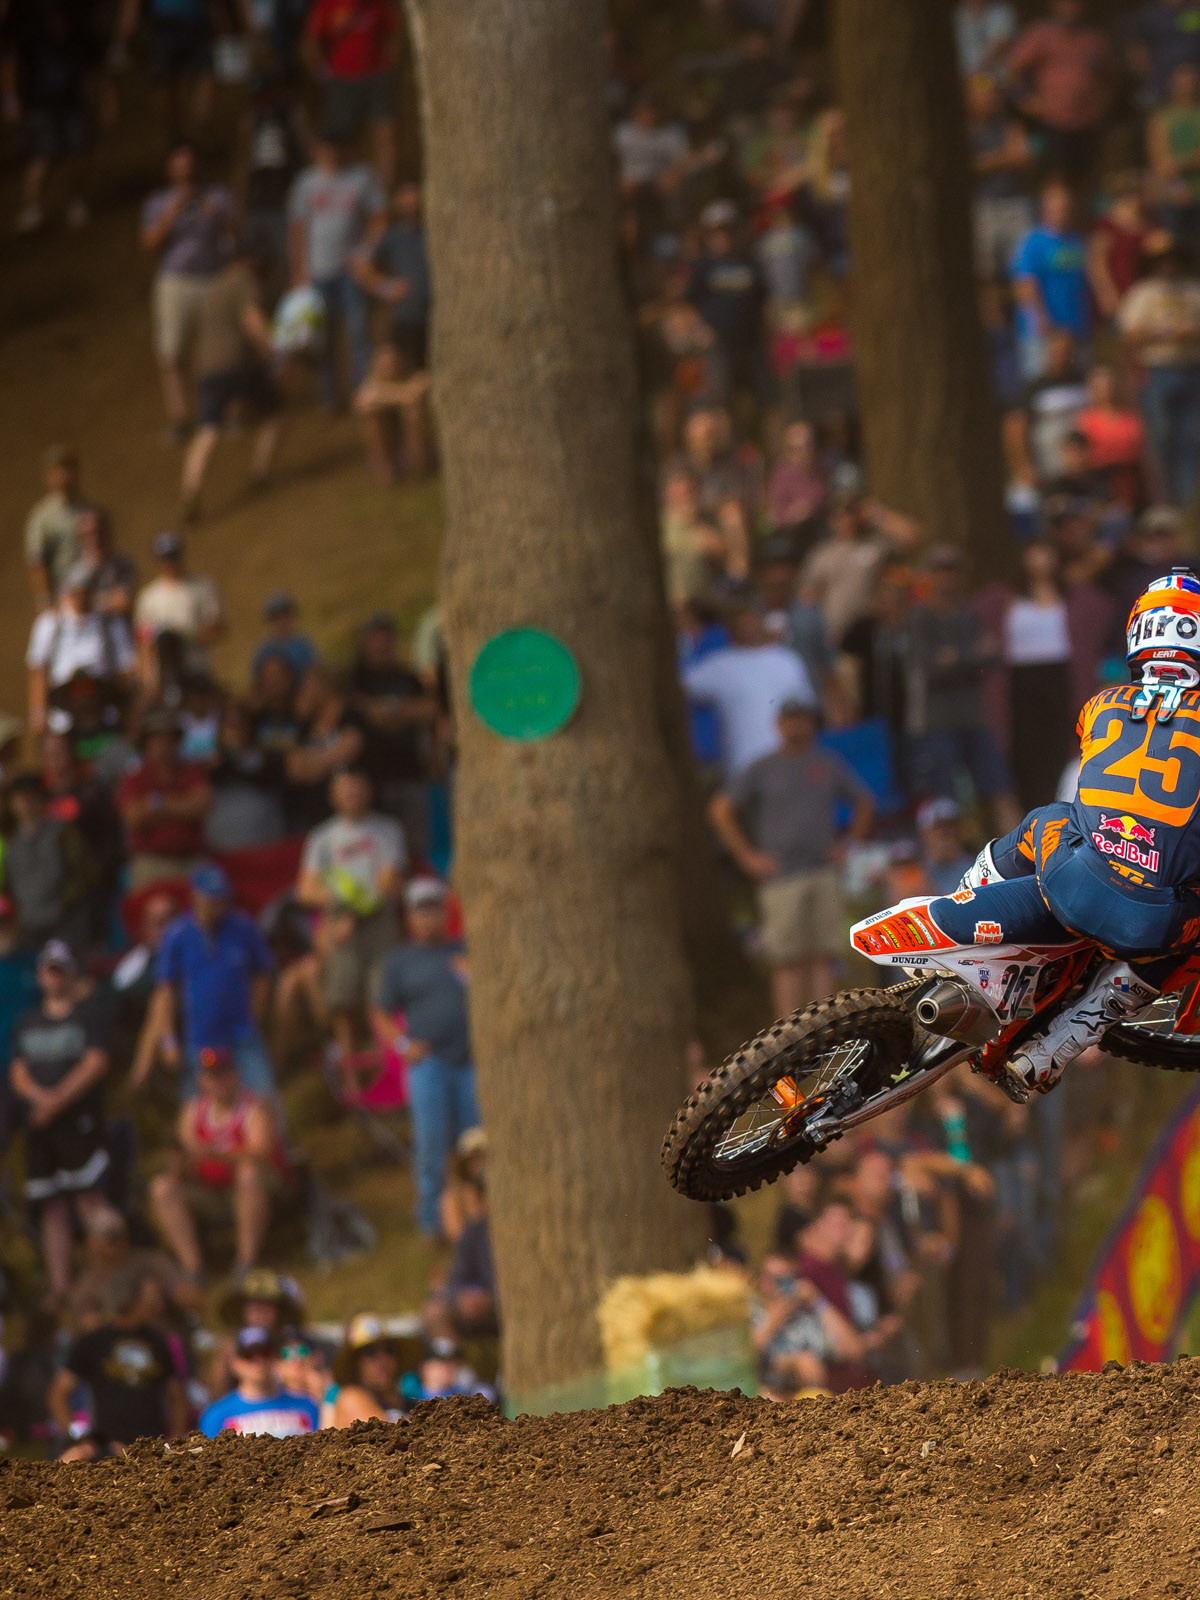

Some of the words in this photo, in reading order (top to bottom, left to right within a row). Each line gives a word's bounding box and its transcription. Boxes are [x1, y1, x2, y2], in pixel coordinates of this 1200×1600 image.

[1153, 650, 1178, 659] LEATT
[1092, 832, 1126, 859] Red
[1126, 842, 1159, 873] Bull
[952, 890, 974, 902] KTM
[865, 910, 893, 926] DUNLOP
[977, 922, 1000, 935] KTM
[891, 956, 929, 965] DUNLOP
[996, 964, 1040, 1020] 25
